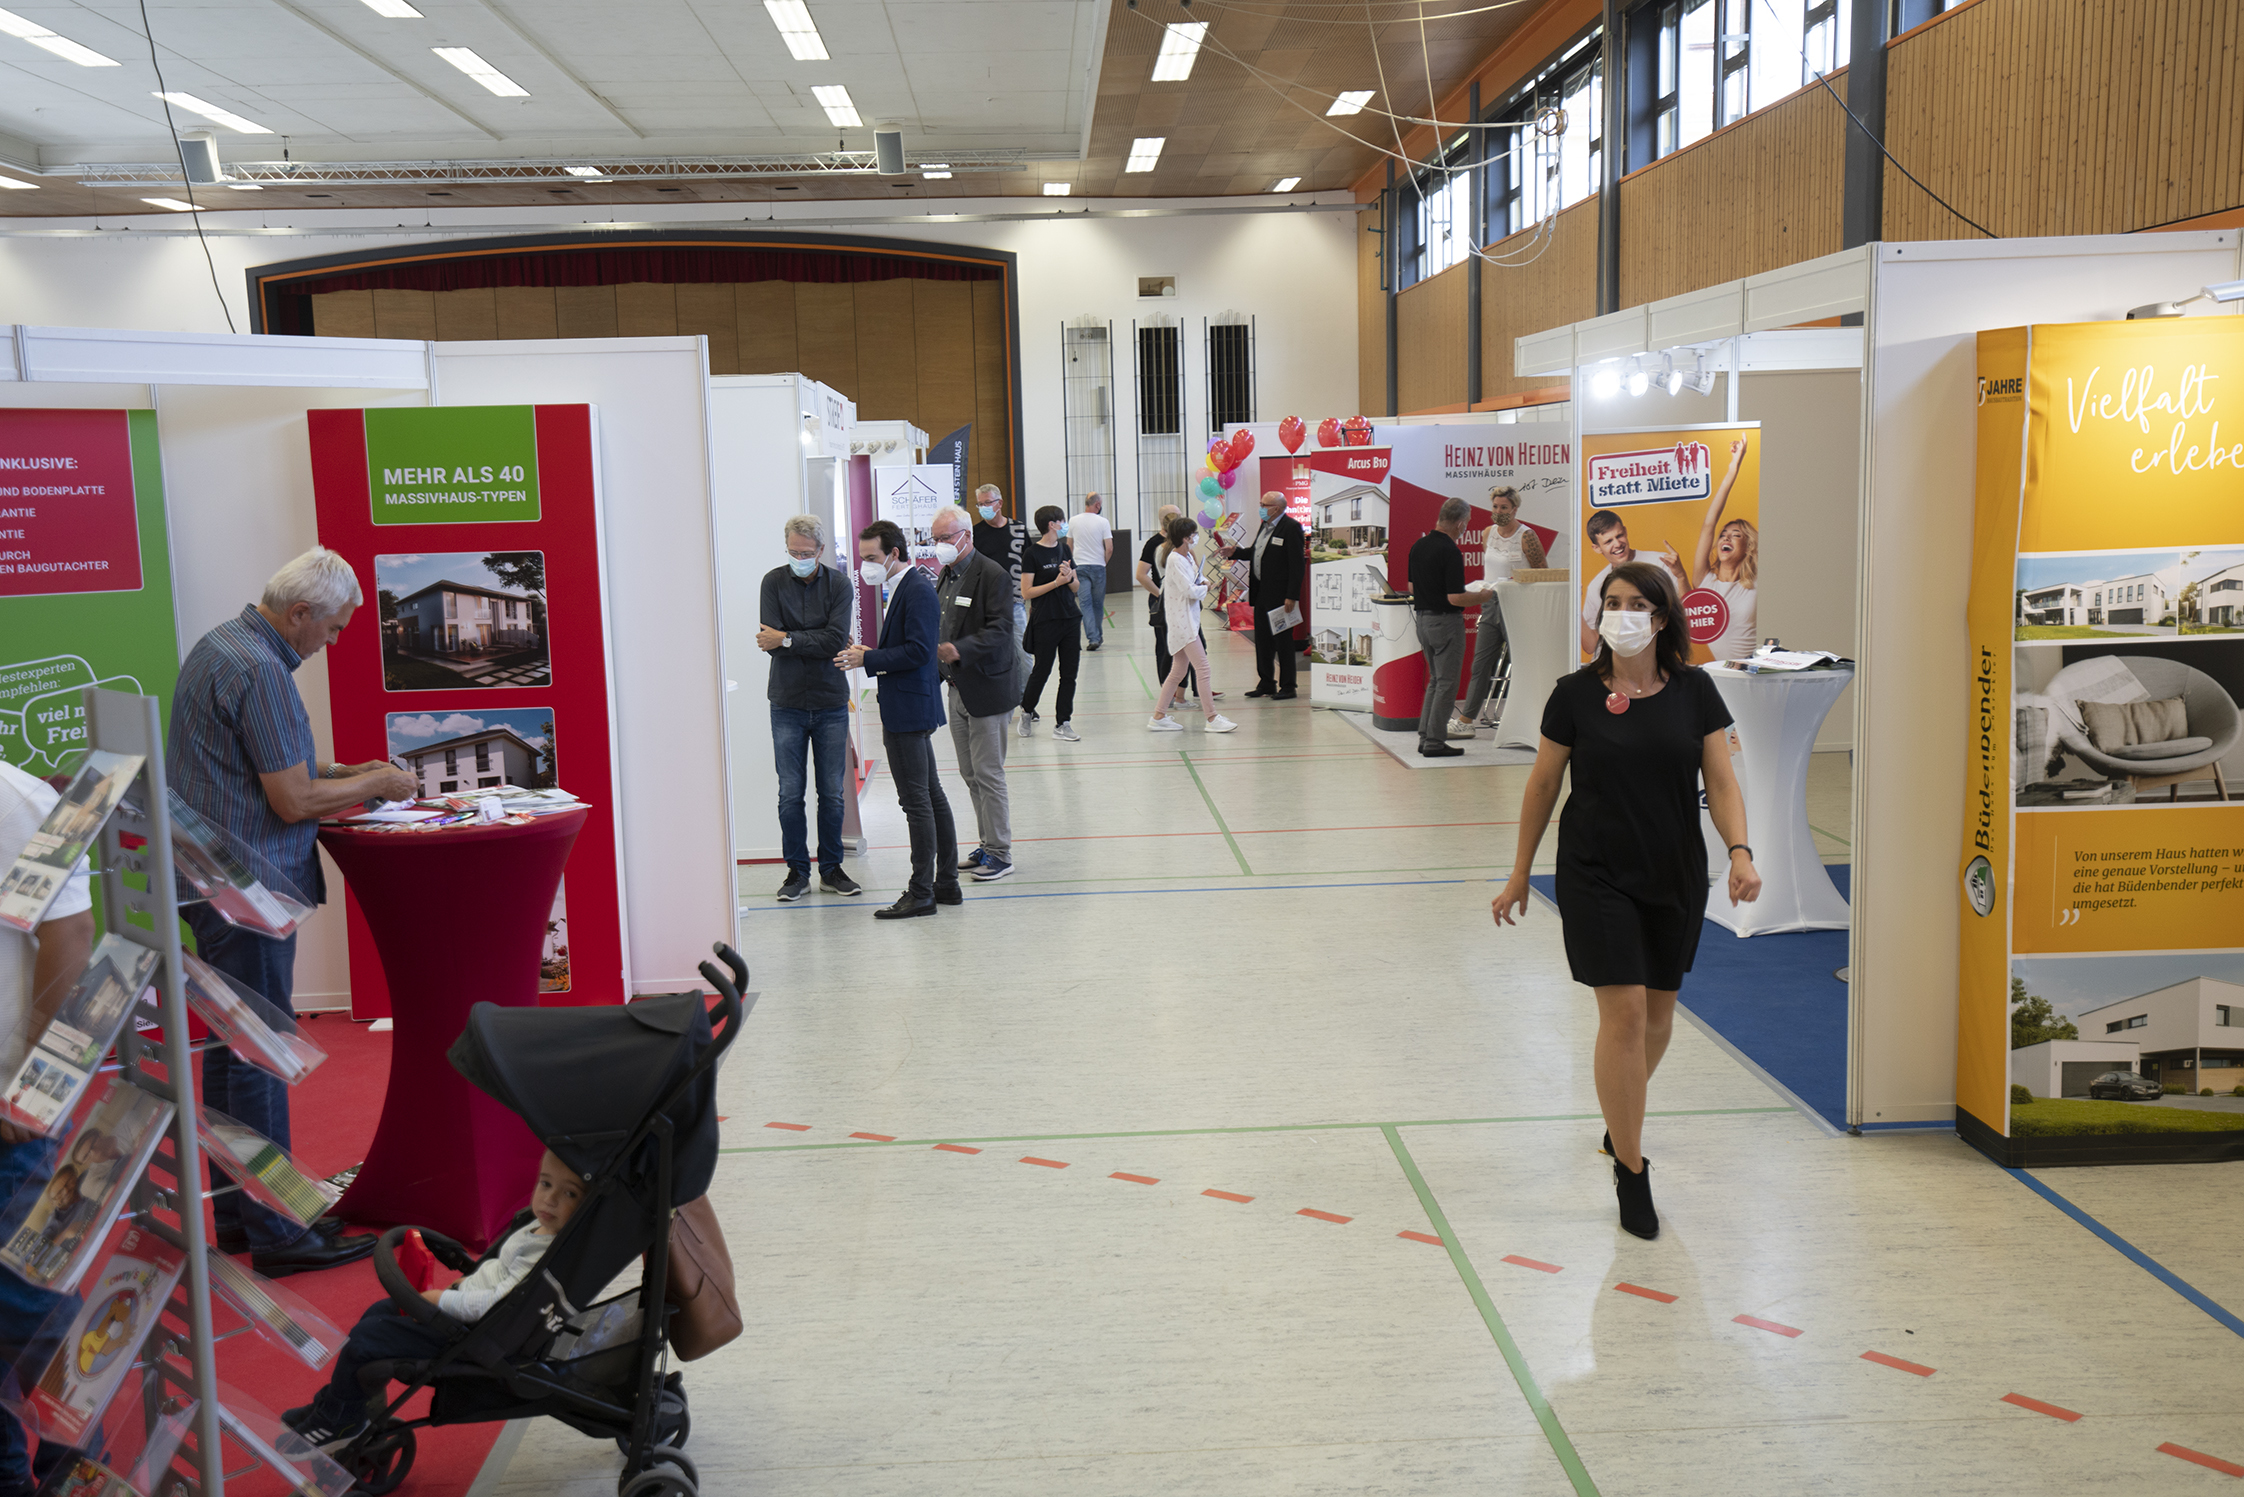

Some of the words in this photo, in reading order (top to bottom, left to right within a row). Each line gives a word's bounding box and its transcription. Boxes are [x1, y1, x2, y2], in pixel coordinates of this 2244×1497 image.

[1986, 377, 2023, 396] JAHRE
[2067, 363, 2220, 434] Vielfalt
[954, 440, 962, 463] HAUS
[1445, 443, 1484, 468] HEINZ
[1487, 445, 1514, 467] VON
[1518, 442, 1570, 466] HEIDEN
[1347, 457, 1371, 469] Arcus
[1373, 456, 1388, 468] B10
[1597, 460, 1672, 480] Freiheit
[383, 467, 447, 485] MEHR
[452, 466, 494, 484] ALS
[499, 465, 525, 483] 40
[1445, 468, 1514, 478] MASSIVHÄUSER
[22, 485, 105, 496] BODENPLATTE
[1598, 480, 1642, 497] statt
[1646, 476, 1700, 492] Miete
[385, 490, 526, 505] MASSIVHAUS-TYPEN
[1294, 496, 1309, 504] Die
[0, 507, 37, 518] ANTIE
[17, 560, 110, 573] BAUGUTACHTER
[1685, 604, 1719, 617] INFOS
[1690, 617, 1716, 628] HIER
[37, 705, 70, 724] viel
[2074, 850, 2098, 862] Von
[2100, 850, 2153, 861] unserem
[2155, 848, 2187, 860] Haus
[2189, 846, 2229, 859] hatten
[2073, 866, 2100, 878] eine
[2102, 866, 2147, 879] genaue
[2149, 863, 2218, 877] Vorstellung
[2073, 881, 2092, 894] die
[2094, 881, 2115, 893] hat
[2117, 879, 2199, 893] Büdenbender
[2200, 877, 2244, 892] perfekt
[2072, 898, 2137, 911] umgesetzt.
